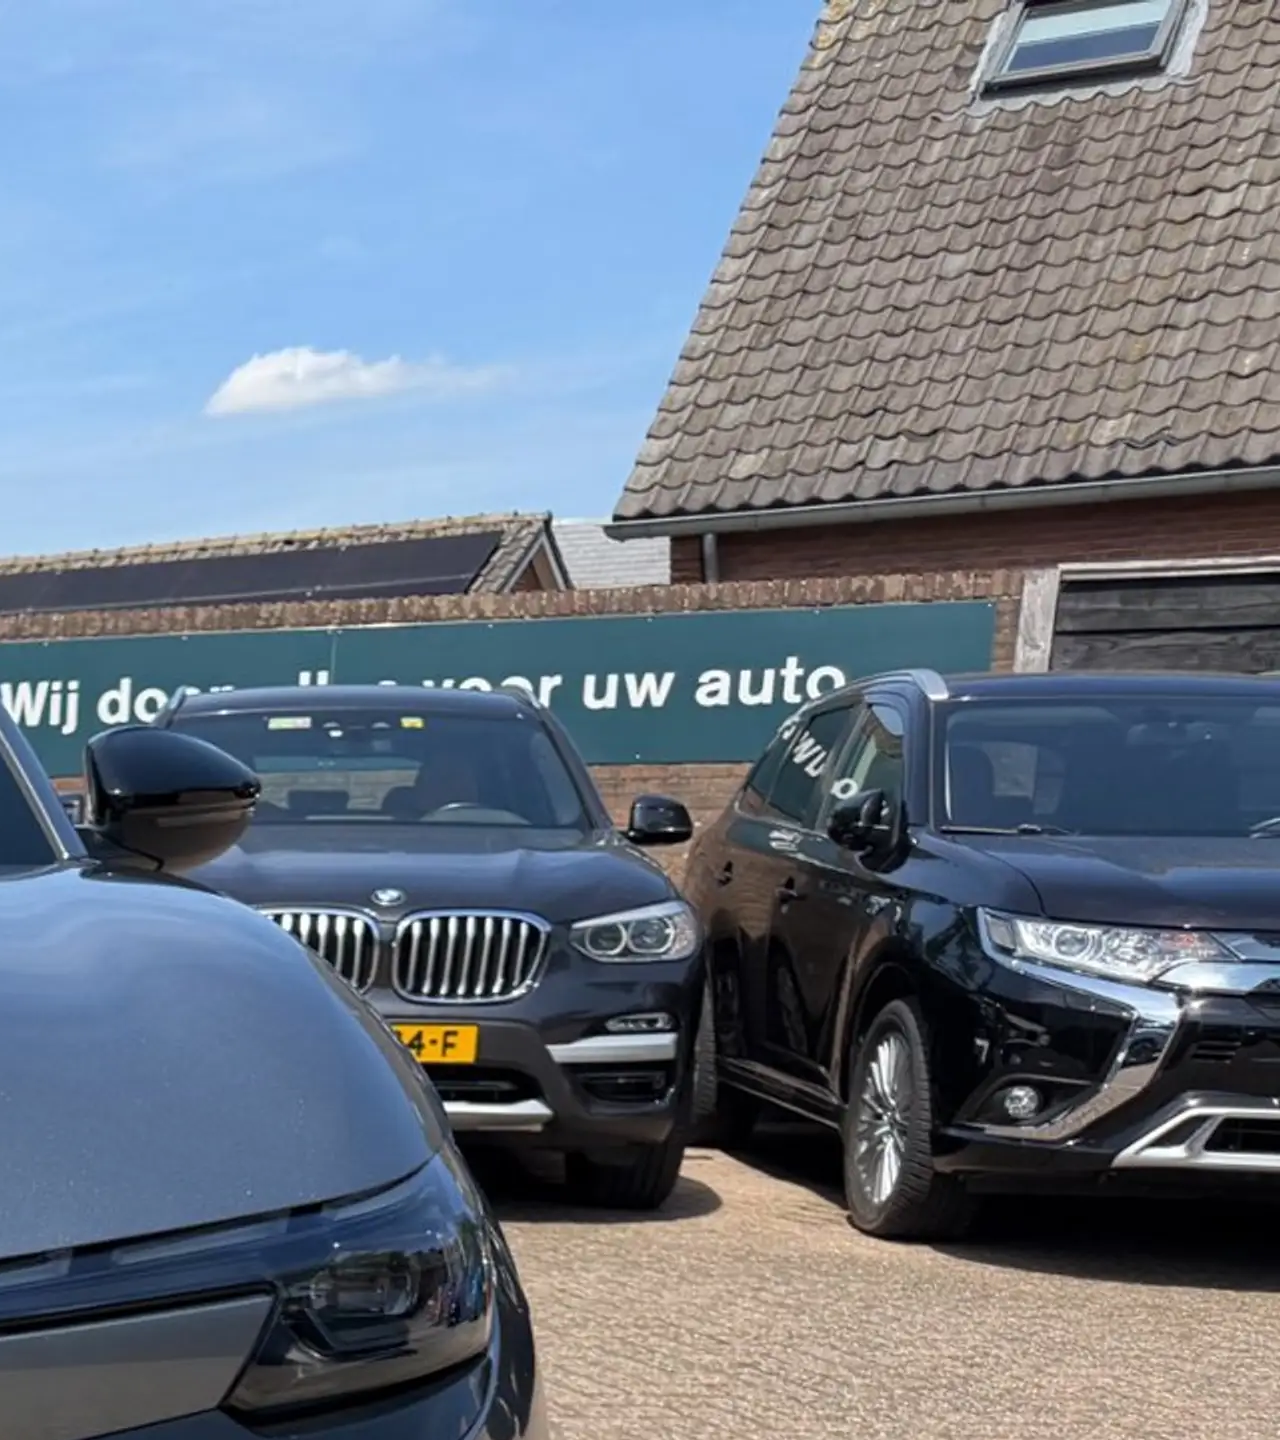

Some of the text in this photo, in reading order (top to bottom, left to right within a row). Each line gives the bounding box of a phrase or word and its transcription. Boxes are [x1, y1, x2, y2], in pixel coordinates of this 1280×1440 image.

[0, 680, 80, 735] Wij
[582, 671, 676, 711] uw
[695, 656, 846, 707] auto
